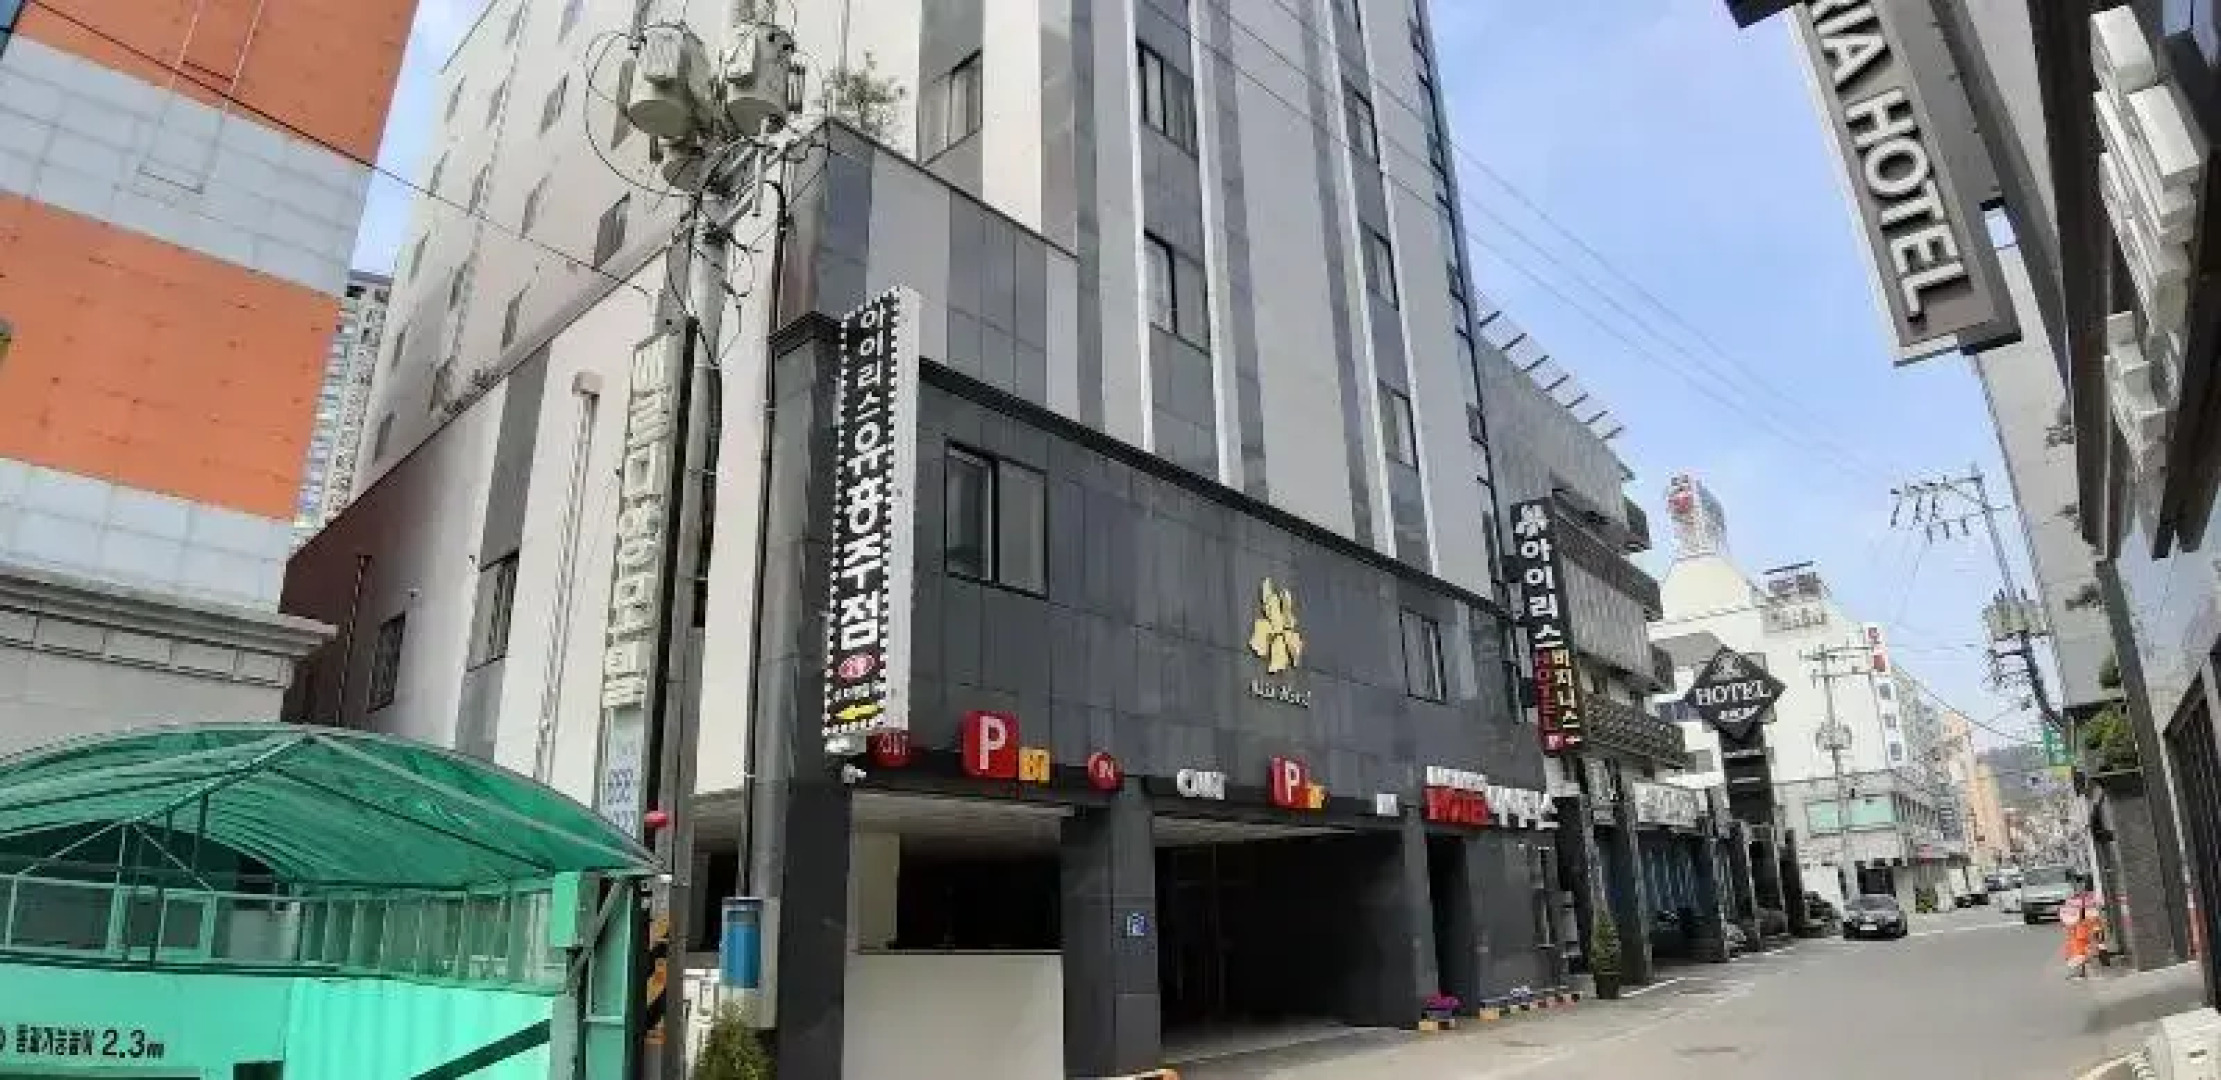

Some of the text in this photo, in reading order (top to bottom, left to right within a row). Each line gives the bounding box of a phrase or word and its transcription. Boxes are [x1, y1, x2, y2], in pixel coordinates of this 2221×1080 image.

[1813, 0, 1965, 313] IA HOTEL
[1520, 538, 1562, 648] 아이리스
[1534, 650, 1559, 732] HOTEL
[1551, 649, 1581, 729] 비지니스
[1695, 680, 1772, 706] HOTEL
[979, 715, 1006, 770] P
[1285, 760, 1300, 803] P
[102, 1029, 165, 1059] 2.3m
